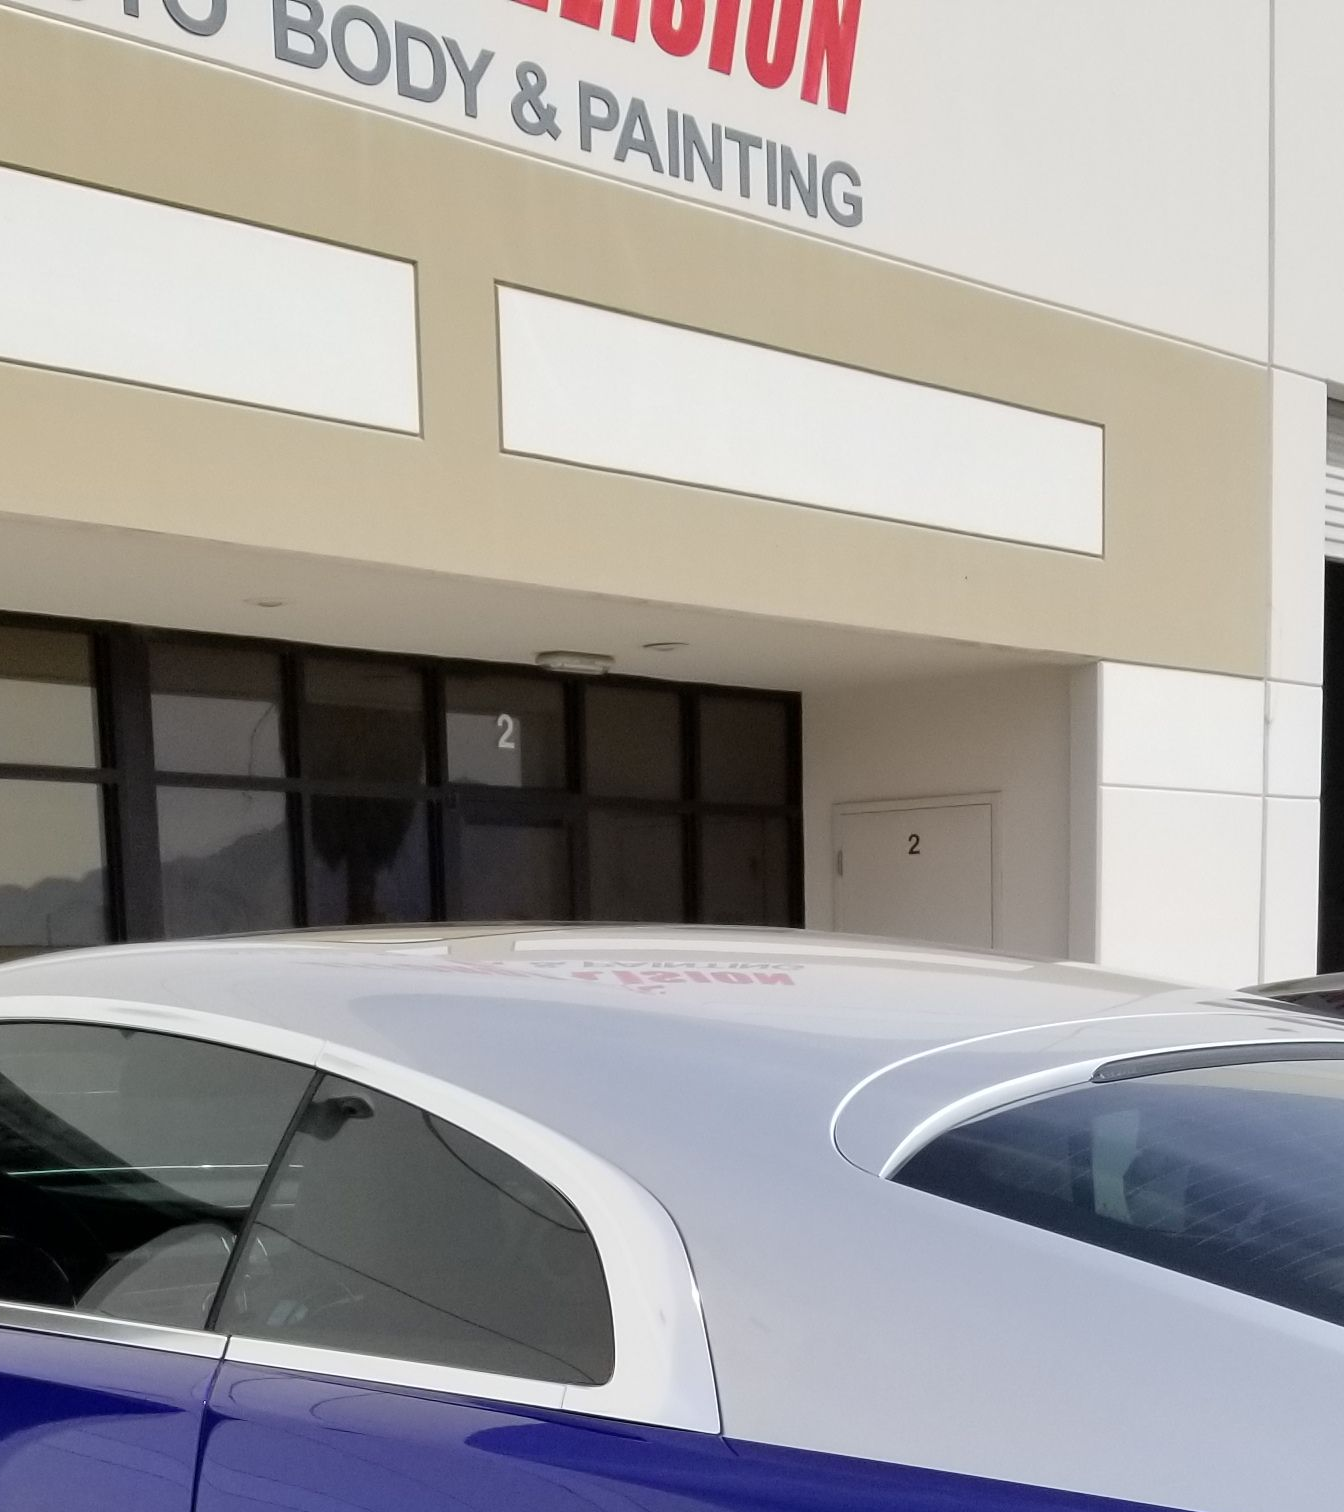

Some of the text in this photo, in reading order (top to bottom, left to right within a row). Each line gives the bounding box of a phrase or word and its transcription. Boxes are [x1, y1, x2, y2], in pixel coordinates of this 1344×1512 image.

[273, 0, 495, 118] BODY
[510, 61, 562, 140] &
[577, 80, 864, 228] PAINTING
[497, 713, 515, 749] 2
[908, 833, 921, 855] 2
